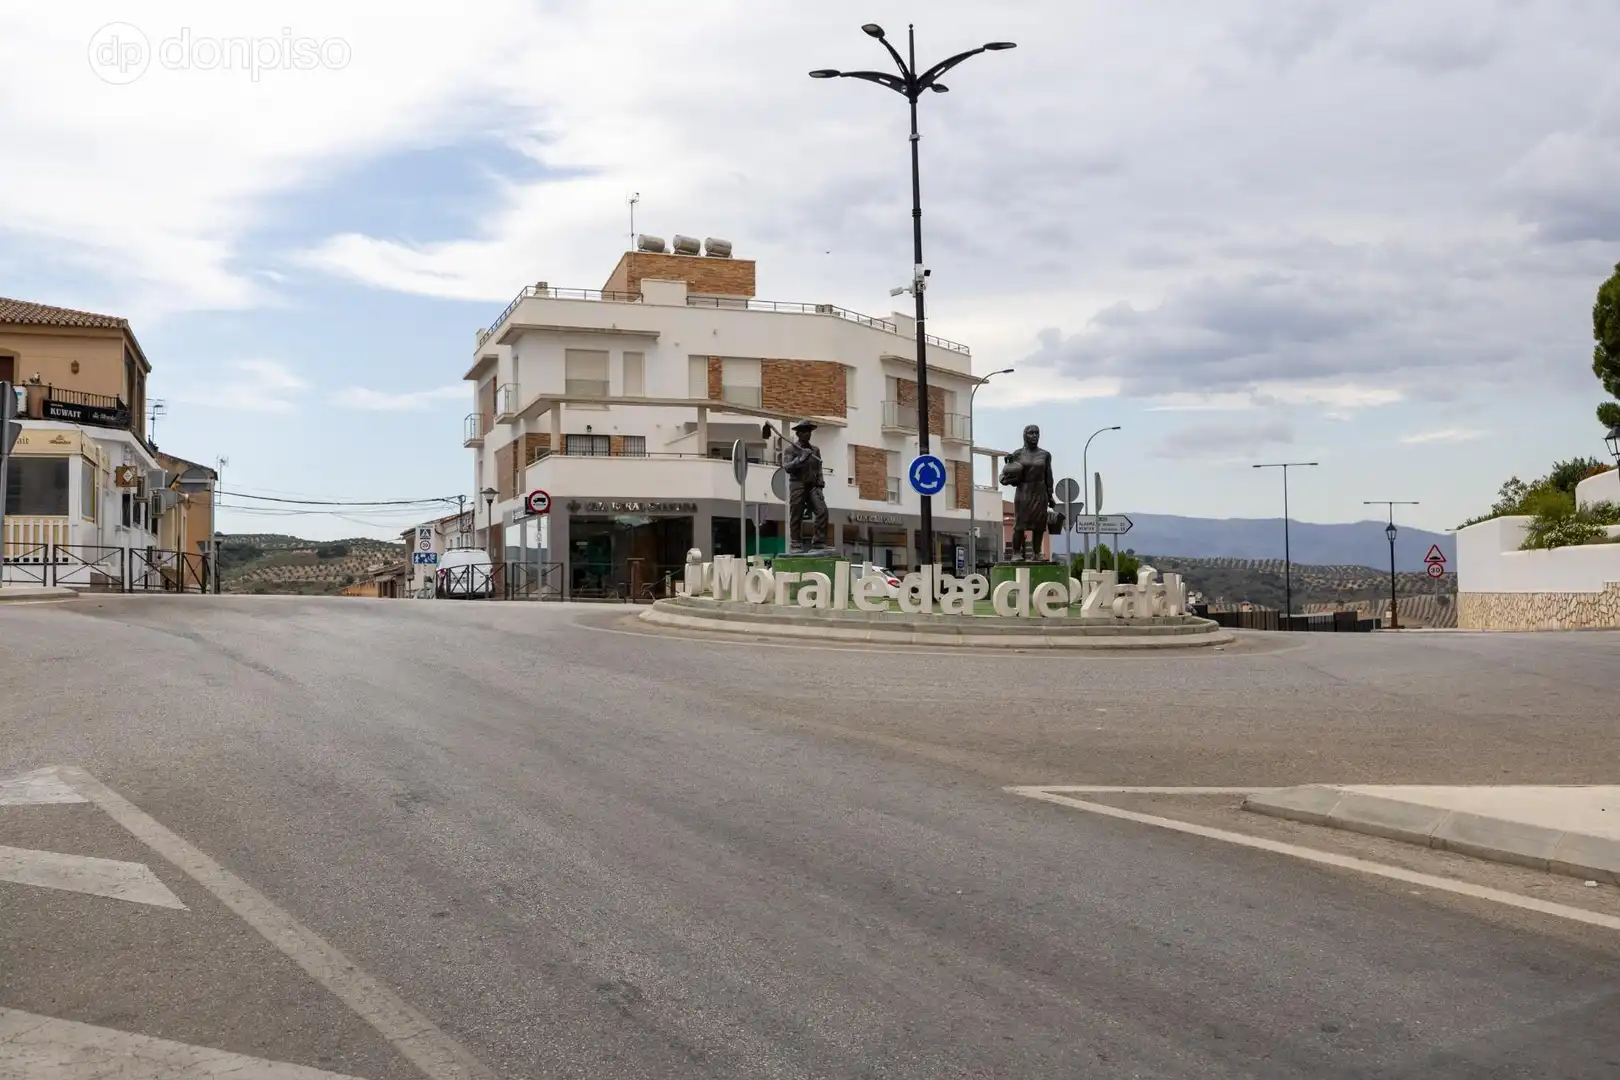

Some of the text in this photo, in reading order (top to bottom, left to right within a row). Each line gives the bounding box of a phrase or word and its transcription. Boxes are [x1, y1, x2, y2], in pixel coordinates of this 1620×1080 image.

[50, 407, 82, 419] KUWAIT
[713, 554, 974, 615] Moraleda
[992, 568, 1069, 618] de
